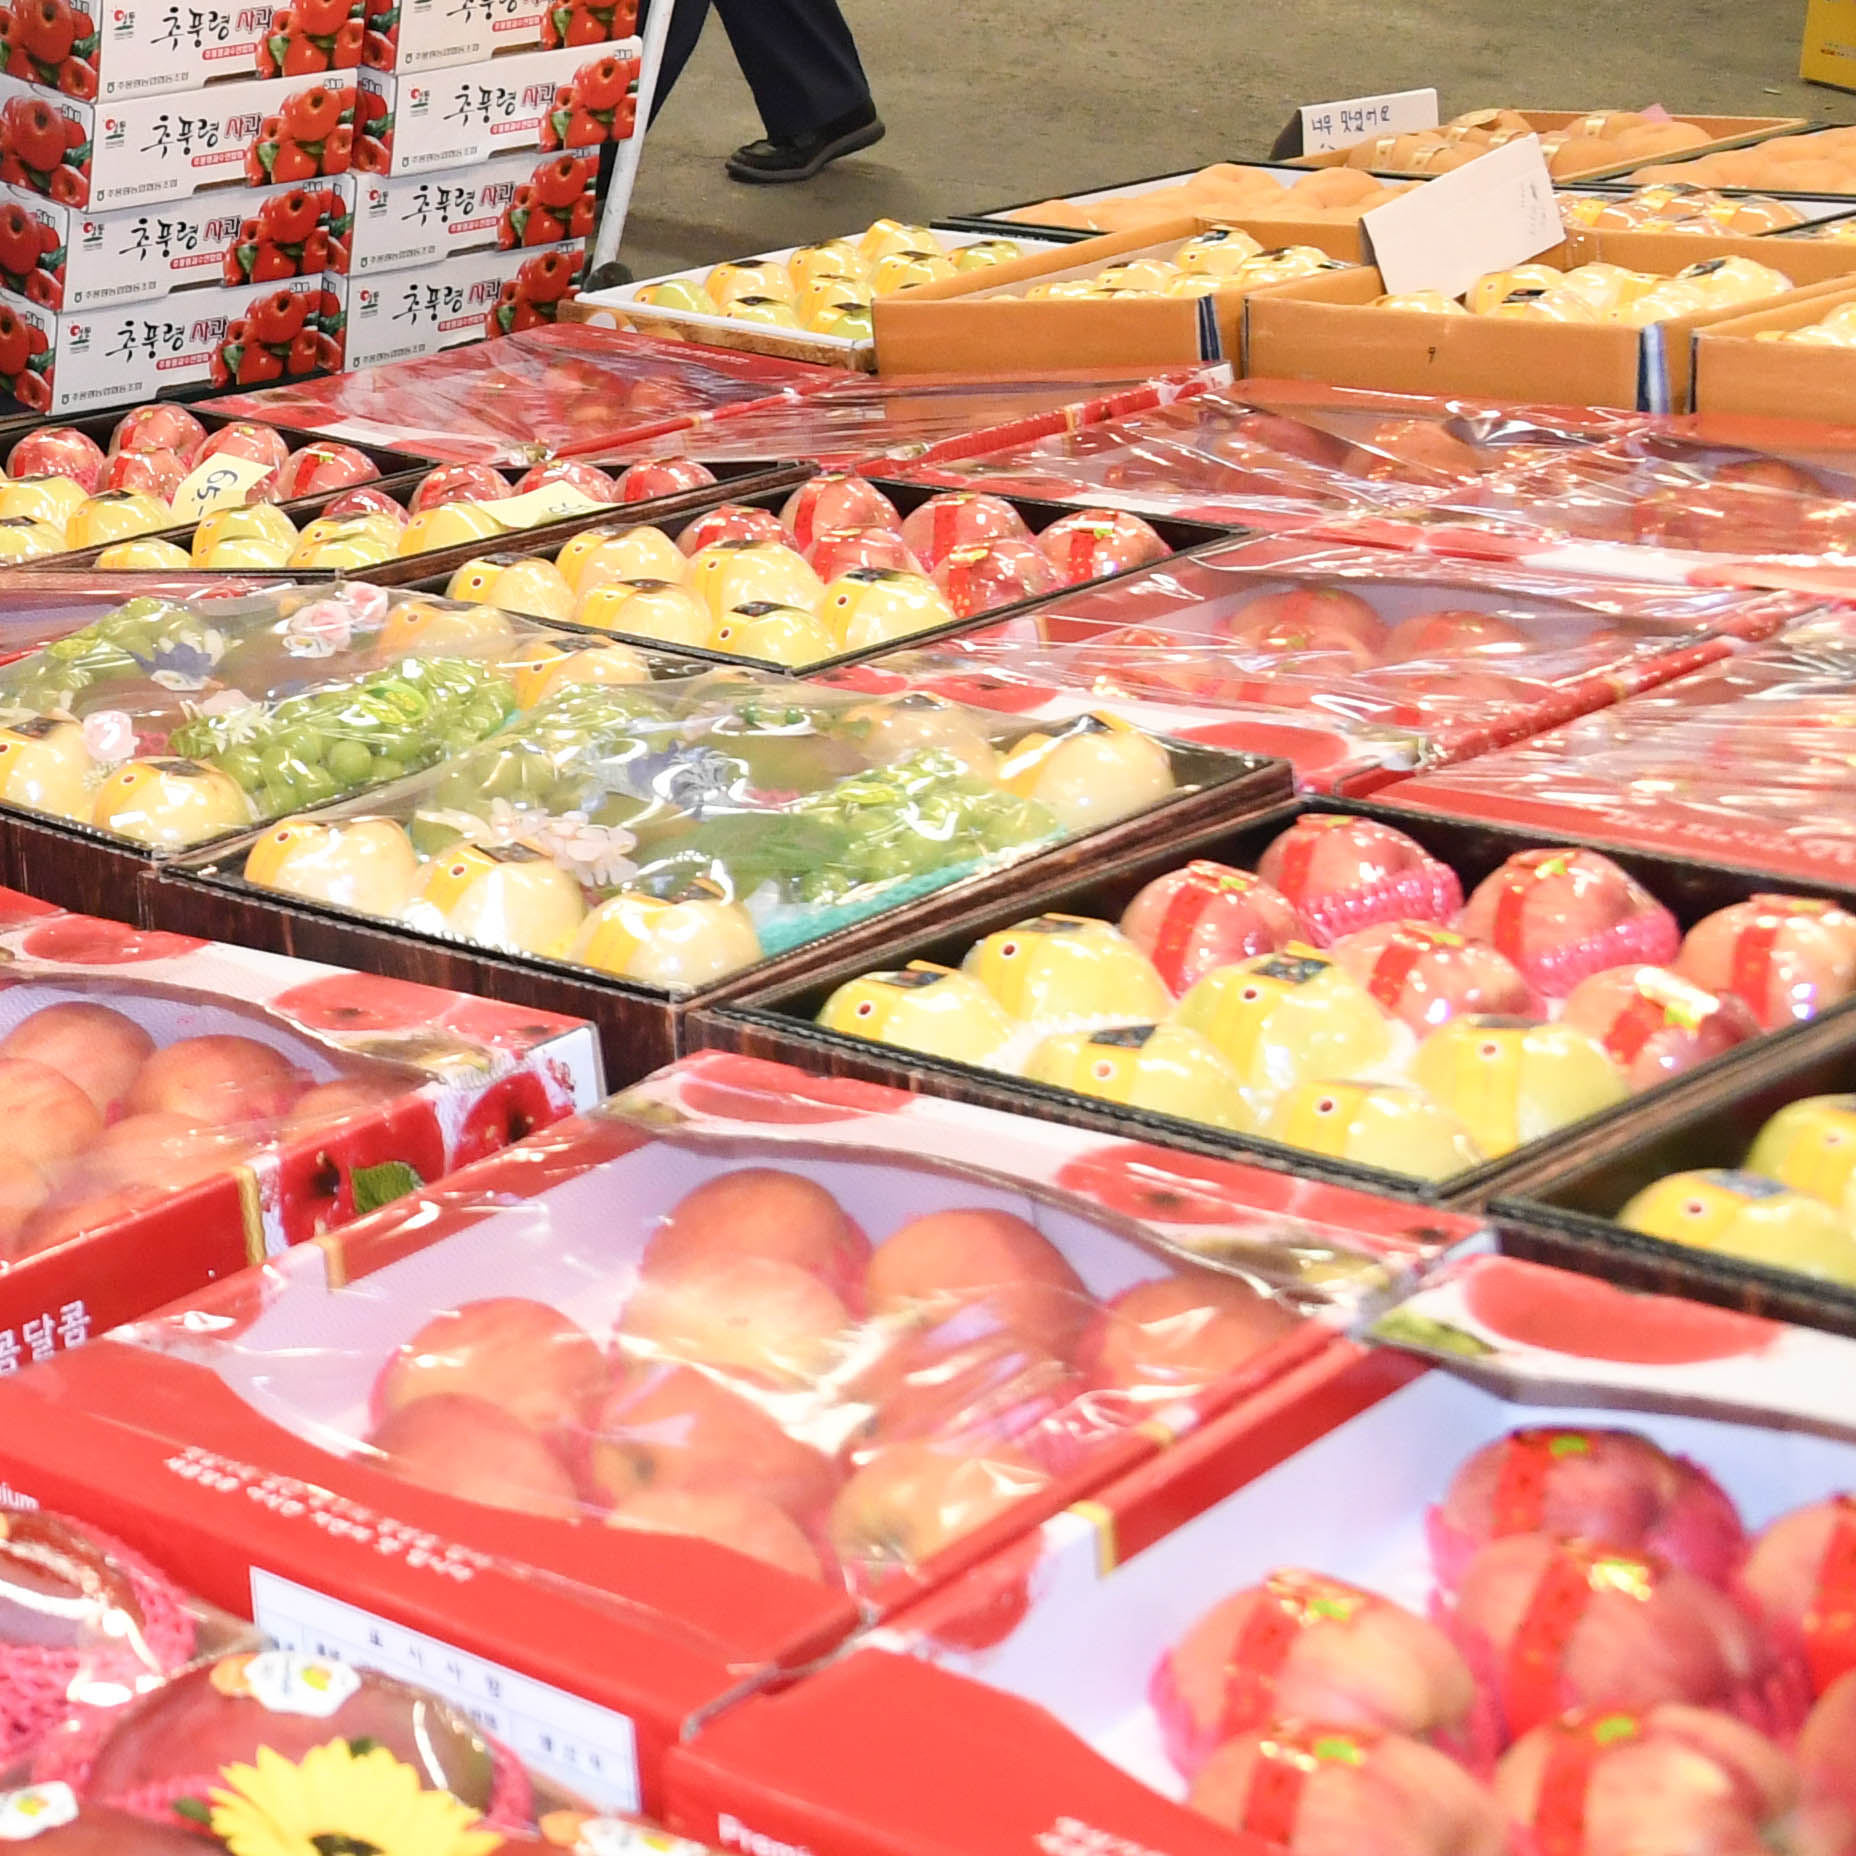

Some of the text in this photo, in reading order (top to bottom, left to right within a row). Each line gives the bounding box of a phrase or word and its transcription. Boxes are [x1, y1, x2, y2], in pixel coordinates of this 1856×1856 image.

[151, 7, 274, 49] 추풍령 사과
[444, 84, 558, 125] 추풍령 사과
[141, 113, 264, 158] 추풍령 사과
[401, 184, 475, 226] 추풍령
[119, 216, 242, 259] 추풍령 사과
[392, 284, 465, 326] 추풍령
[106, 318, 230, 363] 추풍령 사과
